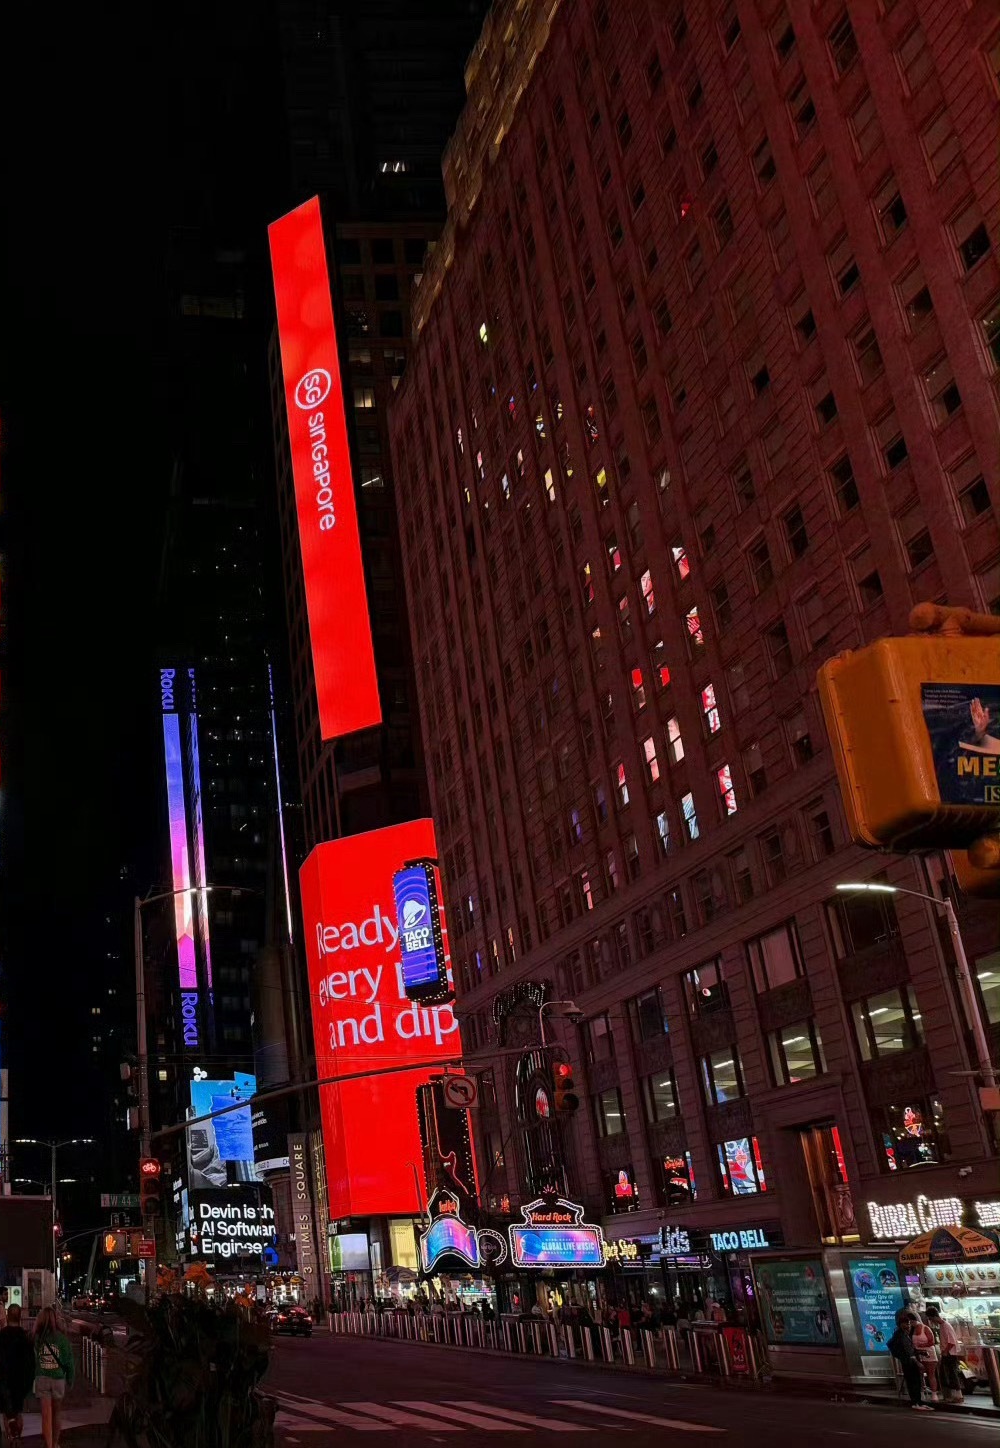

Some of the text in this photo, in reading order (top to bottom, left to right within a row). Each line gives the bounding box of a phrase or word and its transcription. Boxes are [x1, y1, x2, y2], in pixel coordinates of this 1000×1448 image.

[316, 904, 400, 959] Ready
[402, 927, 430, 941] TACO
[405, 939, 431, 952] BELL
[319, 964, 383, 1008] every
[329, 1000, 459, 1050] and dip
[293, 1144, 307, 1200] SQUARE
[200, 1203, 241, 1219] Devin
[243, 1204, 256, 1219] is
[532, 1212, 572, 1222] Hard Rock
[867, 1201, 921, 1238] BUBBA
[300, 1214, 311, 1257] TIMES
[658, 1225, 690, 1254] Lids
[710, 1229, 769, 1251] TACO BELL
